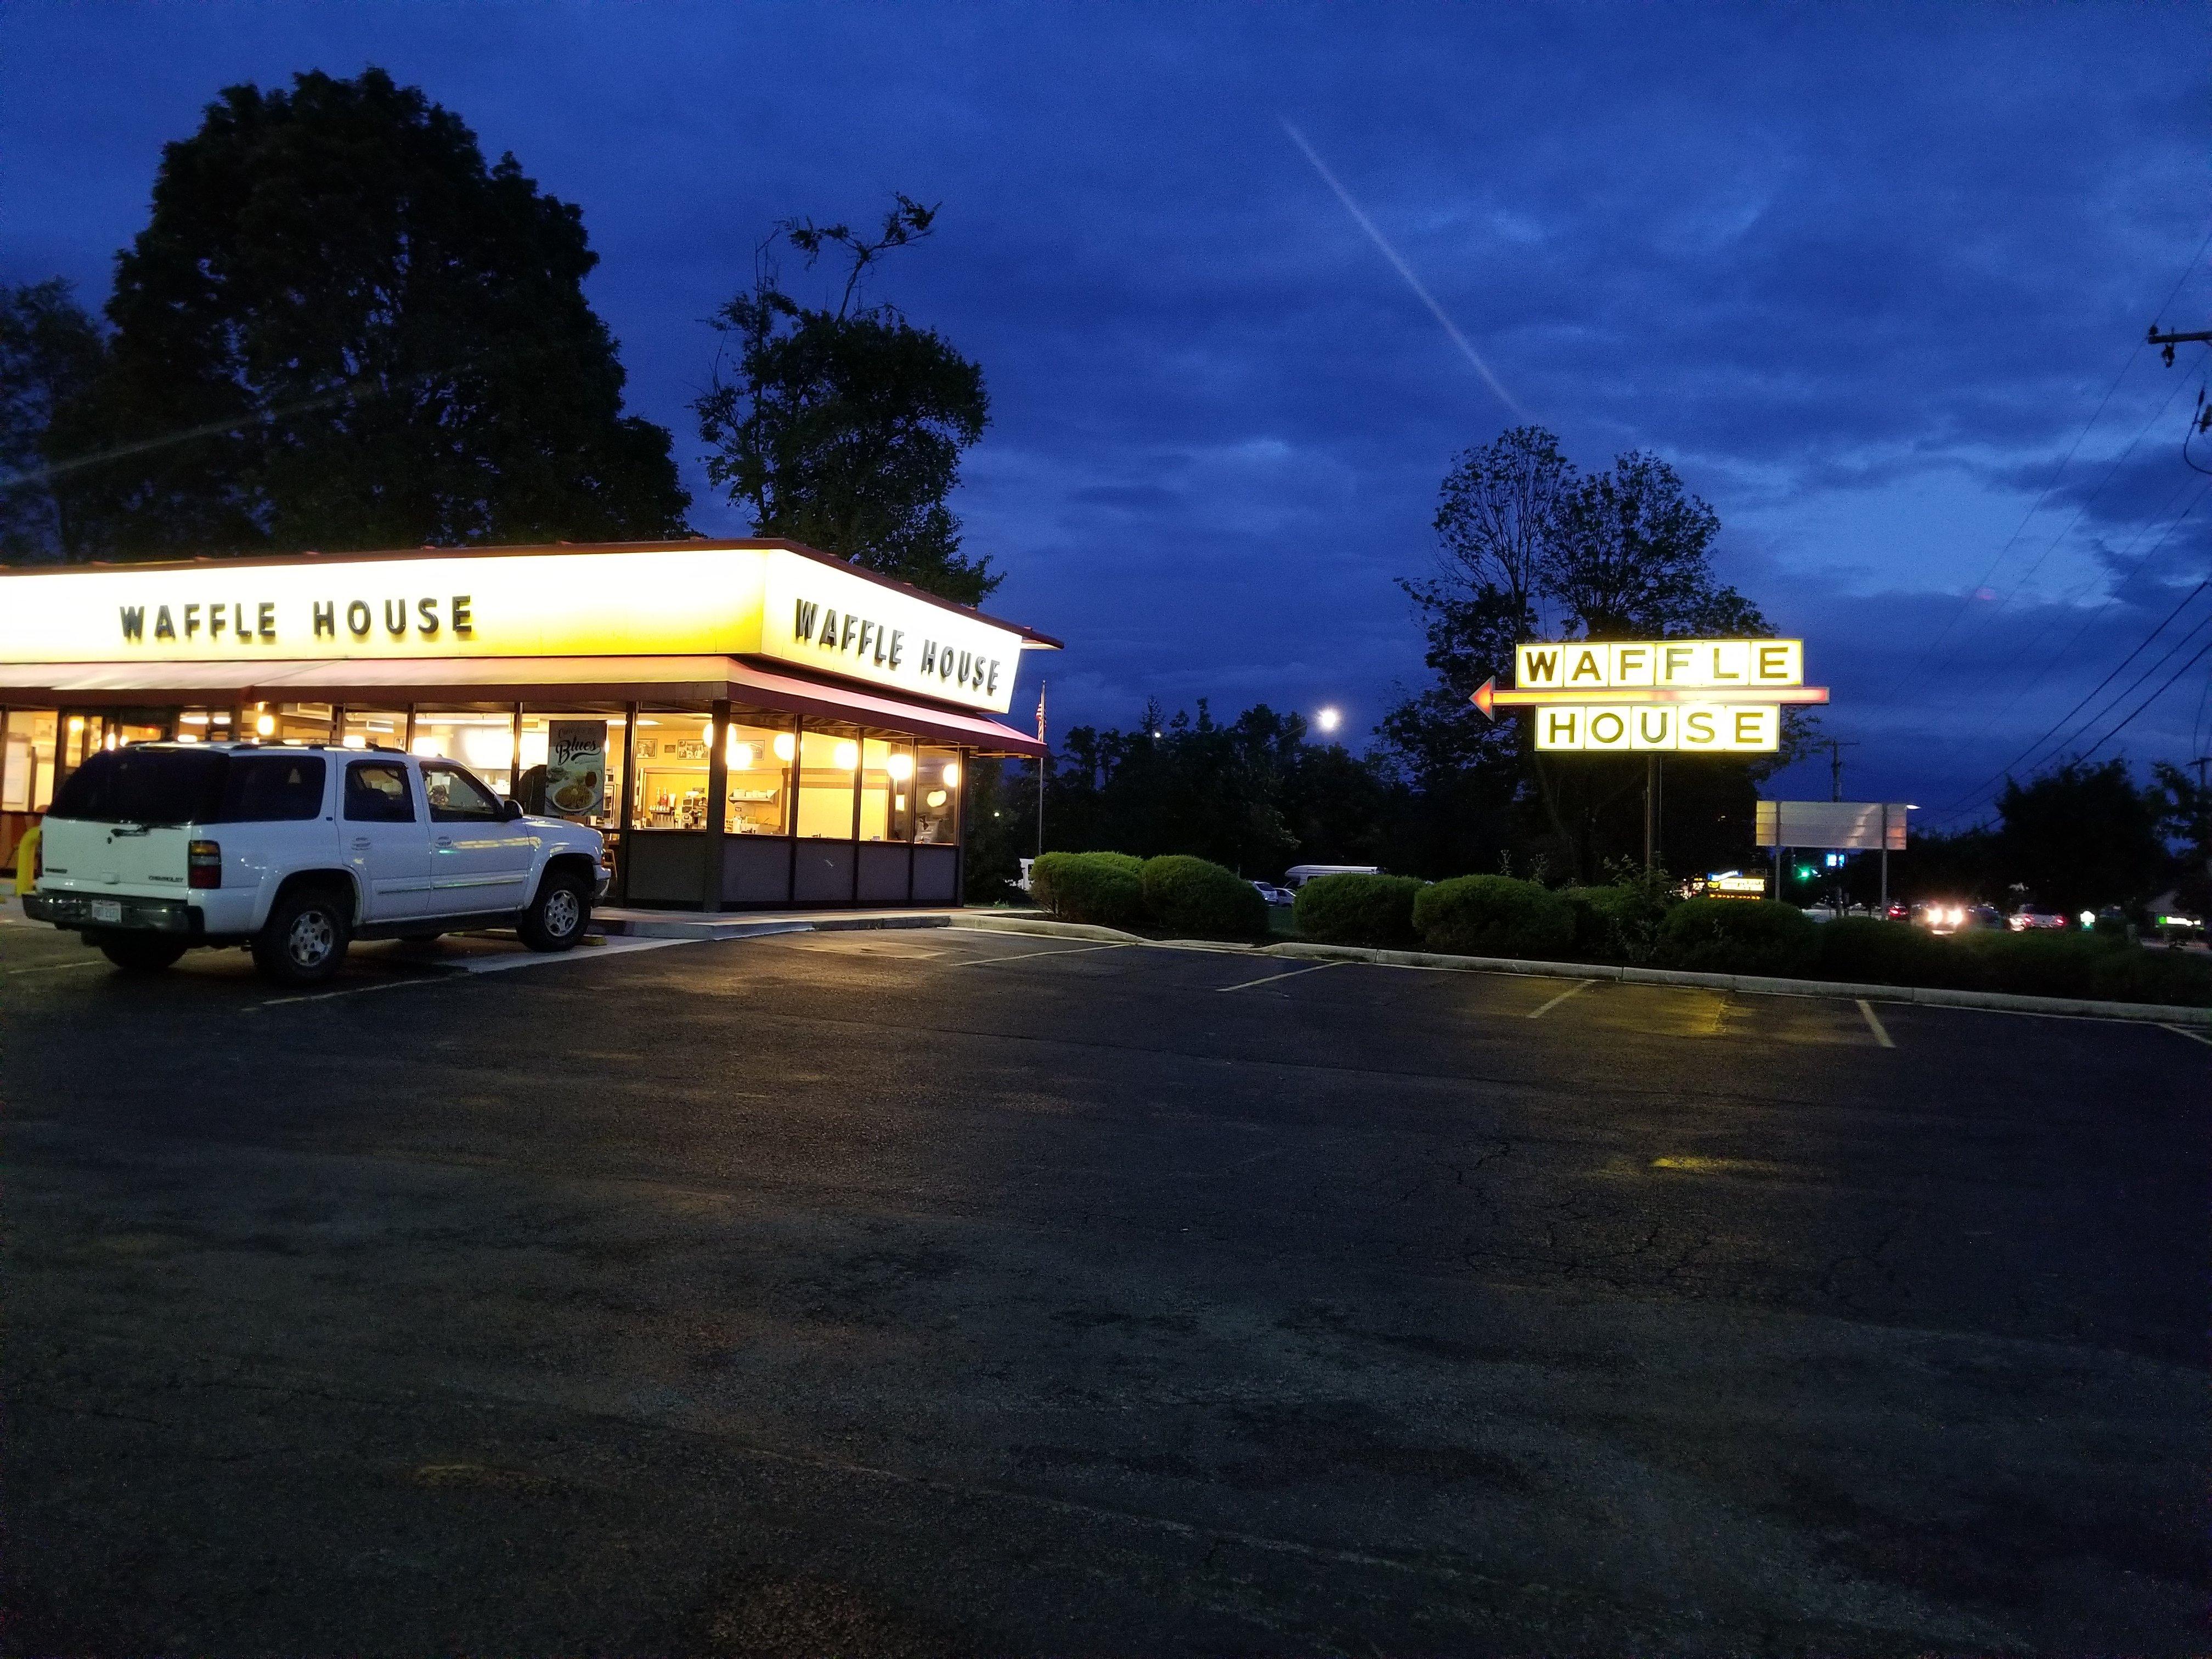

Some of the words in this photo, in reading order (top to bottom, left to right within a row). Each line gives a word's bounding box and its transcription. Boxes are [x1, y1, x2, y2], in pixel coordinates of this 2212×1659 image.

[120, 602, 276, 638] WAFFLE
[313, 595, 472, 636] HOUSE
[795, 599, 904, 664] WAFFLE
[921, 639, 1000, 690] HOUSE
[1526, 647, 1788, 681] WAFFLE
[1549, 712, 1763, 743] HOUSE
[556, 737, 598, 765] Blues
